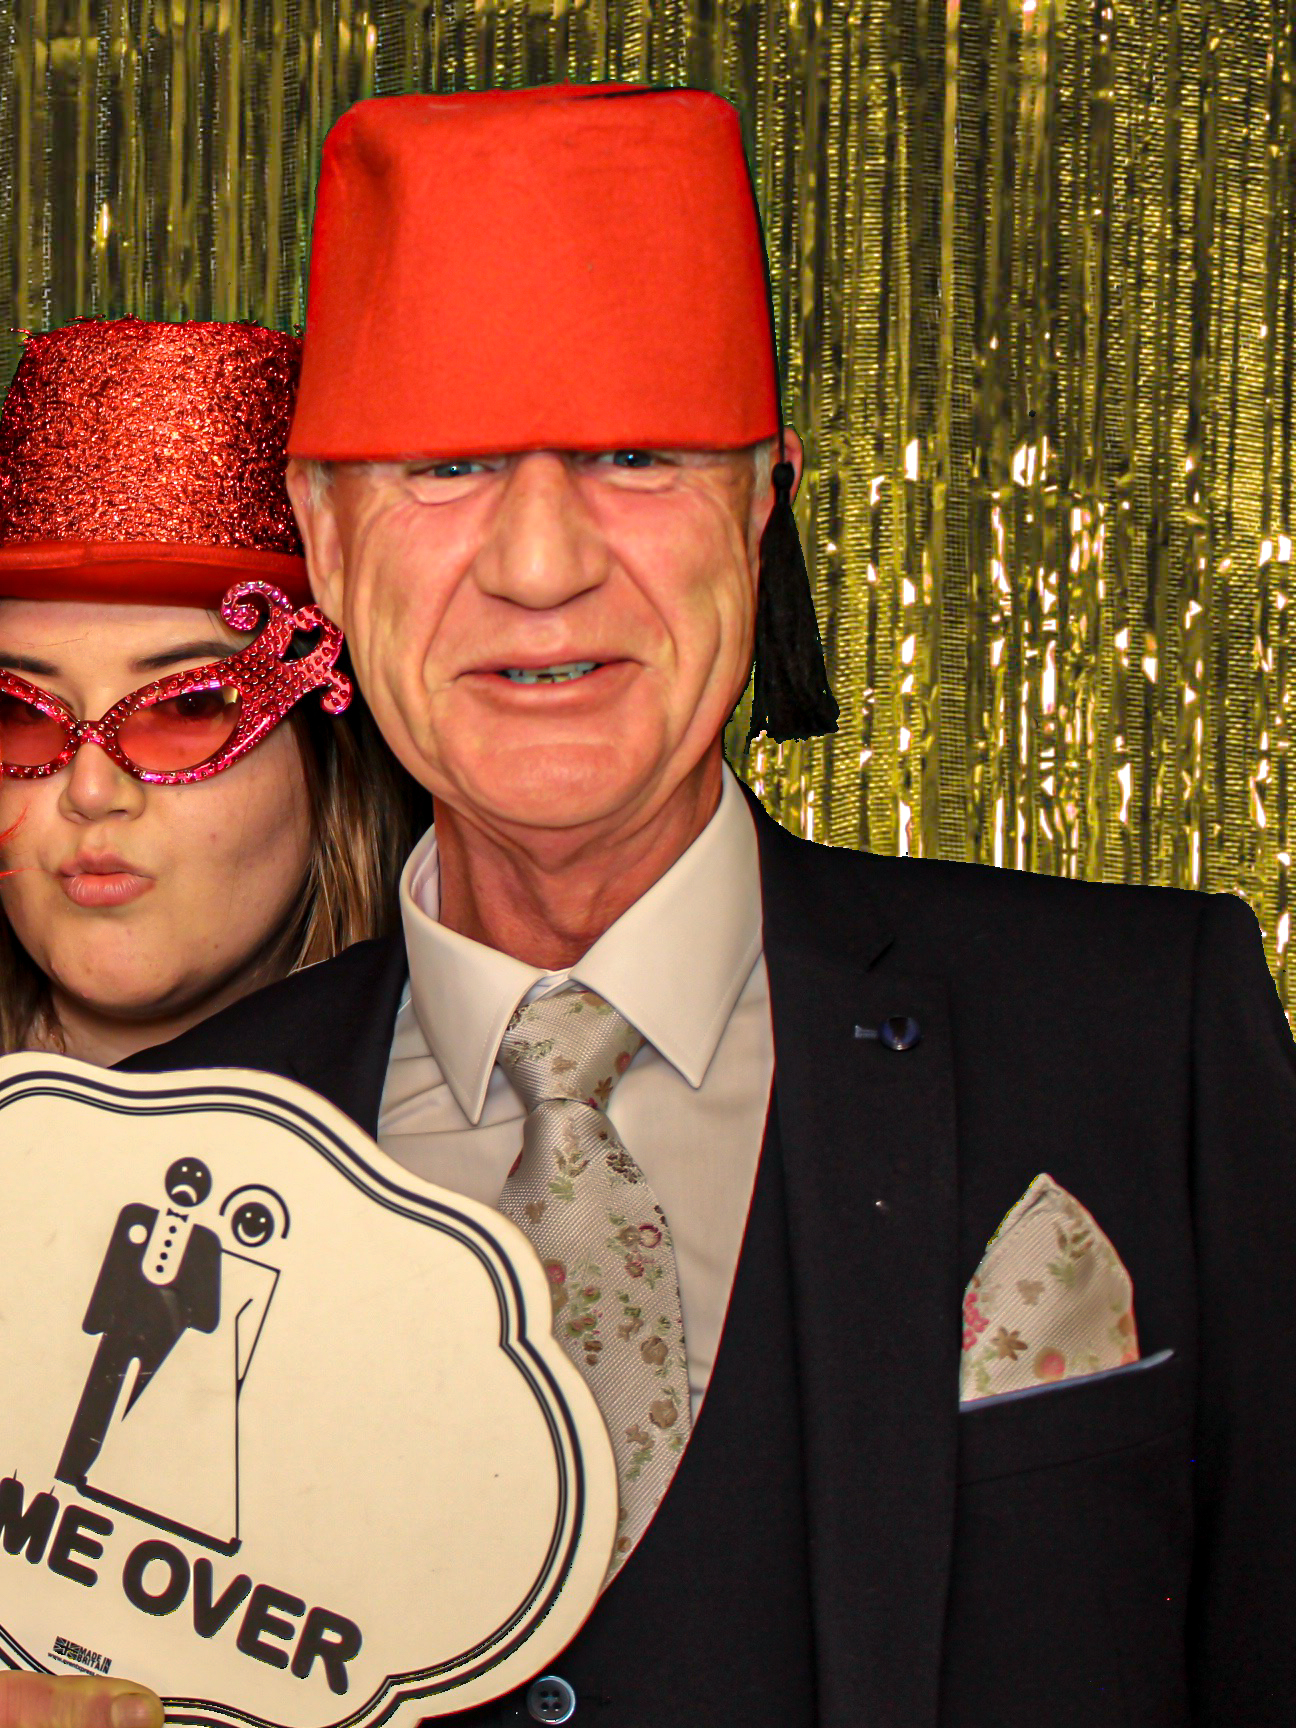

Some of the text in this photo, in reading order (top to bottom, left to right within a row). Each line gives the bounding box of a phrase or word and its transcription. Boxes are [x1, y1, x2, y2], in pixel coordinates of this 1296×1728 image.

[122, 1539, 363, 1695] OVER
[76, 1654, 111, 1674] BRITAIN
[79, 1646, 112, 1666] MADE IN
